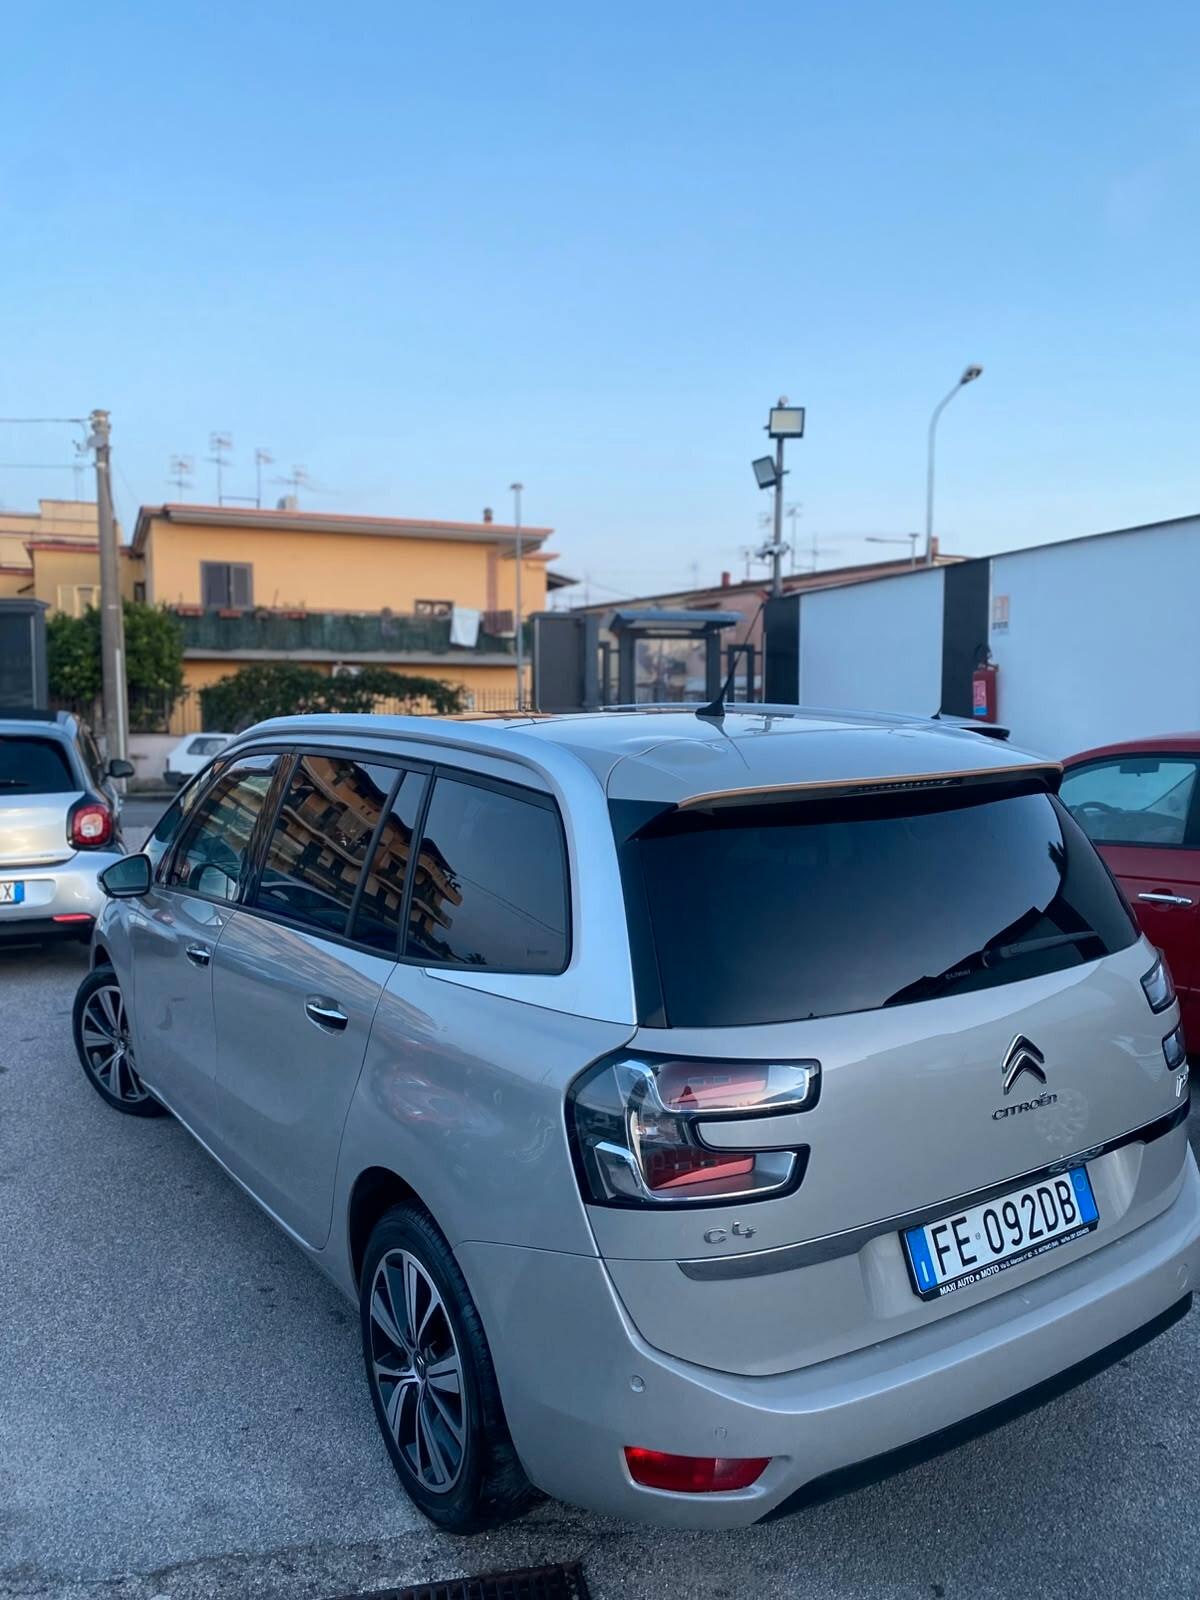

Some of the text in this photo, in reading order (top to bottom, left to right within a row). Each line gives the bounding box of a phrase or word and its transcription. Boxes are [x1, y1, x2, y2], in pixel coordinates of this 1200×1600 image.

[704, 1221, 757, 1244] C4
[931, 1180, 1077, 1276] FE 092DB
[921, 1261, 930, 1283] I
[939, 1281, 957, 1296] MAXI
[957, 1275, 975, 1290] AUTO
[980, 1264, 1000, 1279] MOTO
